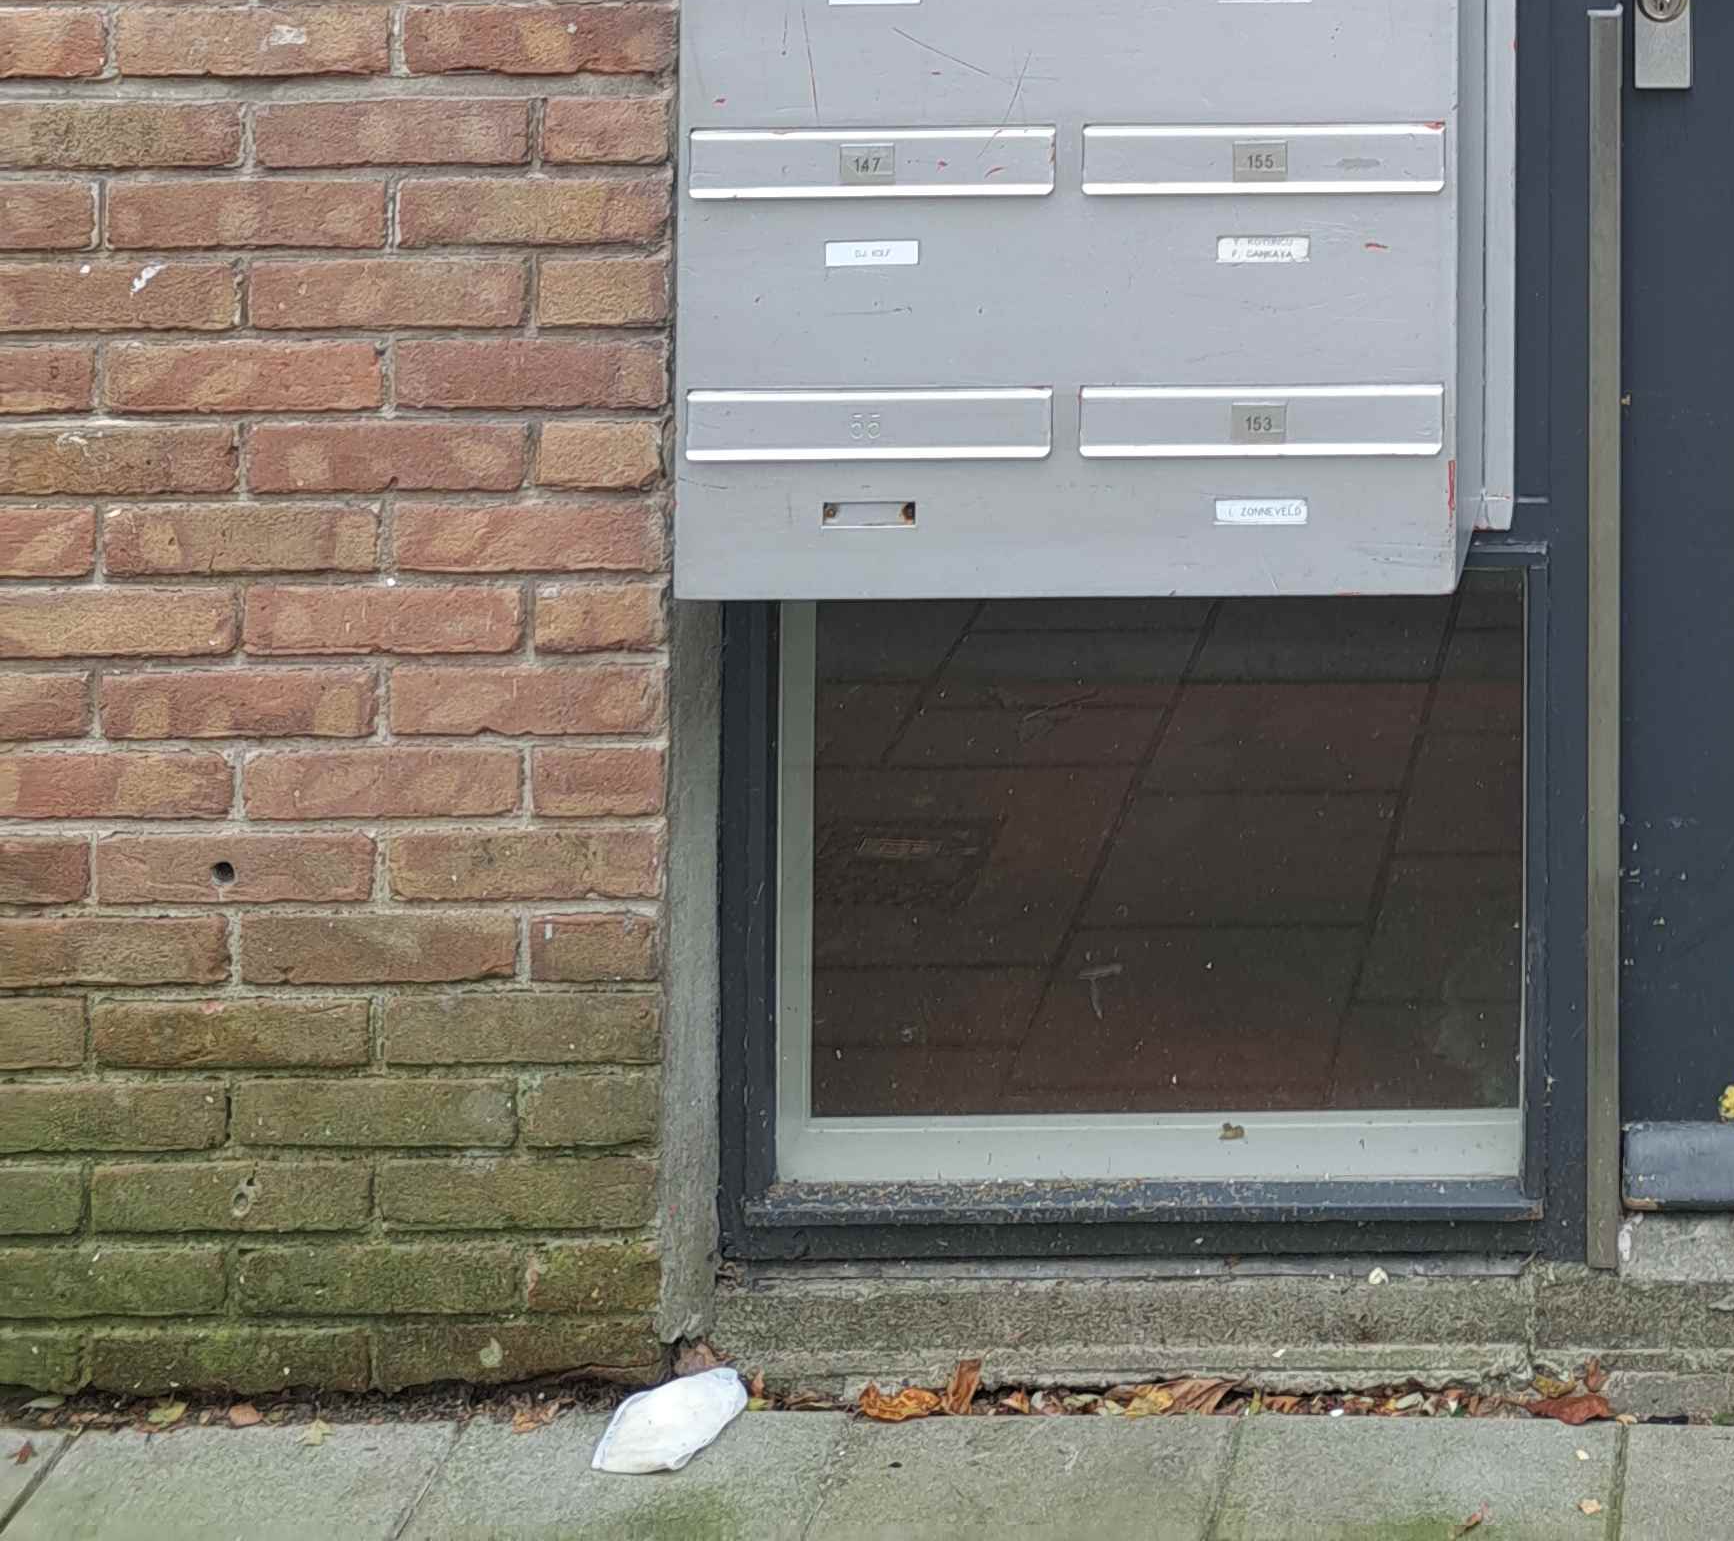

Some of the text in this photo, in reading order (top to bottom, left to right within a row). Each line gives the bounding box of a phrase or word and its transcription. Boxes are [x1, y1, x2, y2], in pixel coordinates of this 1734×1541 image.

[853, 158, 880, 173] 147
[1247, 154, 1274, 169] 155
[1245, 417, 1272, 431] 153
